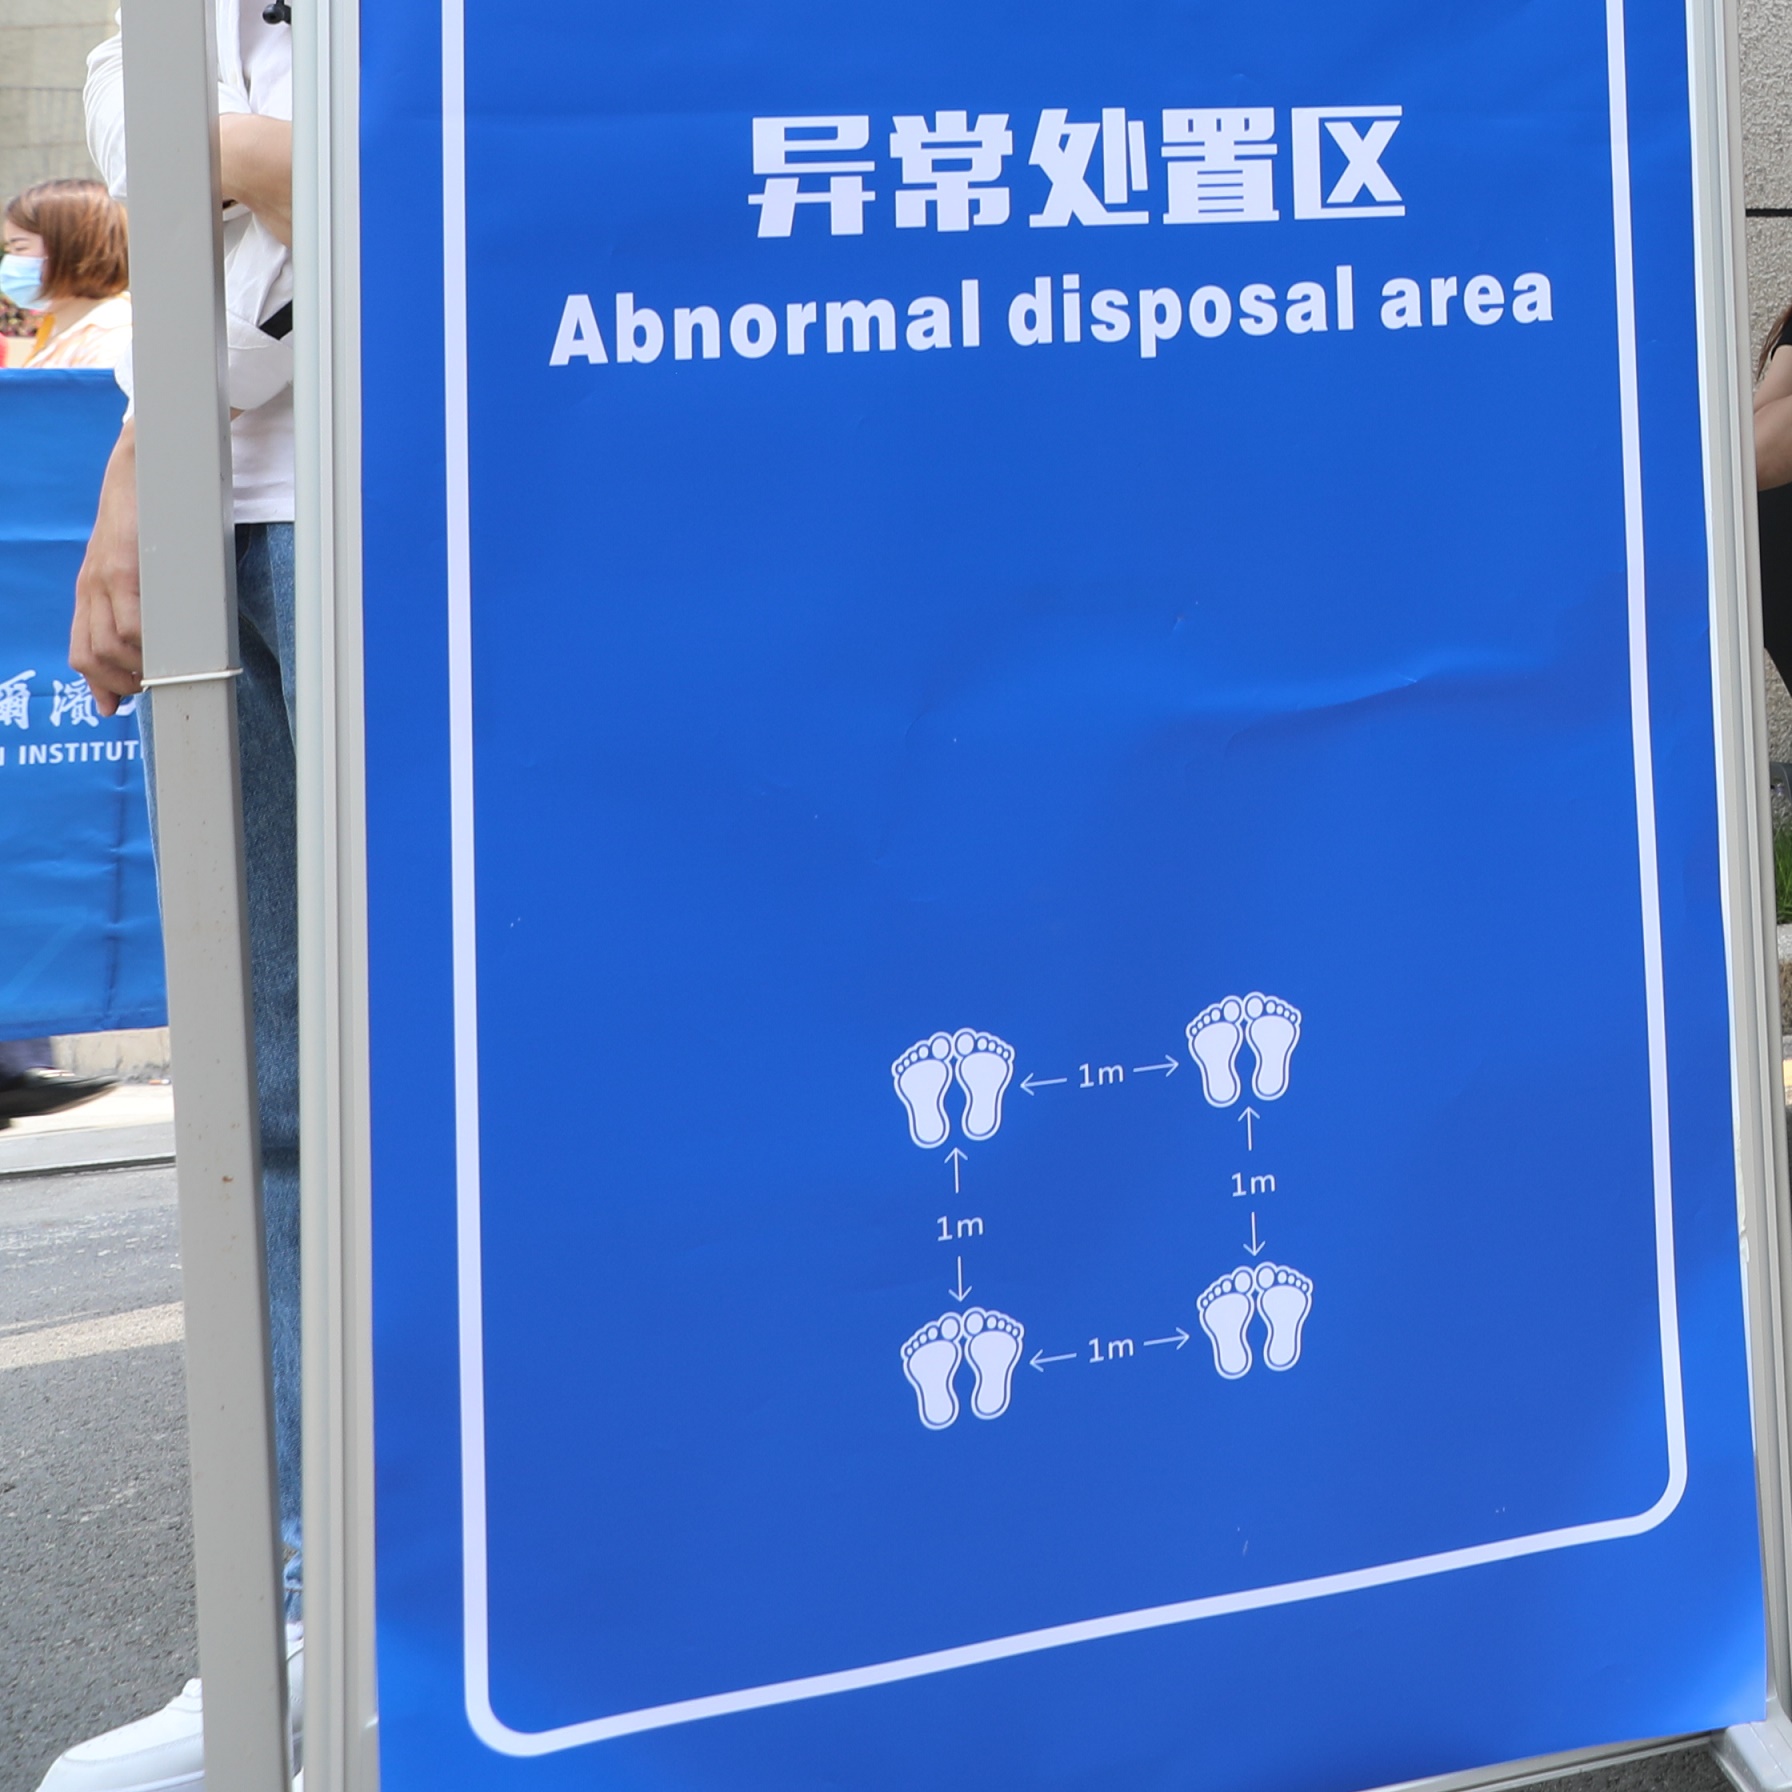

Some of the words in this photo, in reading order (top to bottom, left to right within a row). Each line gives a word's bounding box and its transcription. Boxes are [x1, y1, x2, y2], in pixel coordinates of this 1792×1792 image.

[747, 104, 1405, 239] 异常处置区
[548, 278, 981, 366] Abnormal
[1007, 264, 1355, 358] disposal
[1379, 270, 1553, 329] area
[19, 740, 143, 766] INSTITUT
[1077, 1063, 1124, 1088] 1m
[1231, 1172, 1276, 1197] 1m
[936, 1215, 984, 1241] 1m
[1088, 1337, 1134, 1363] 1m
